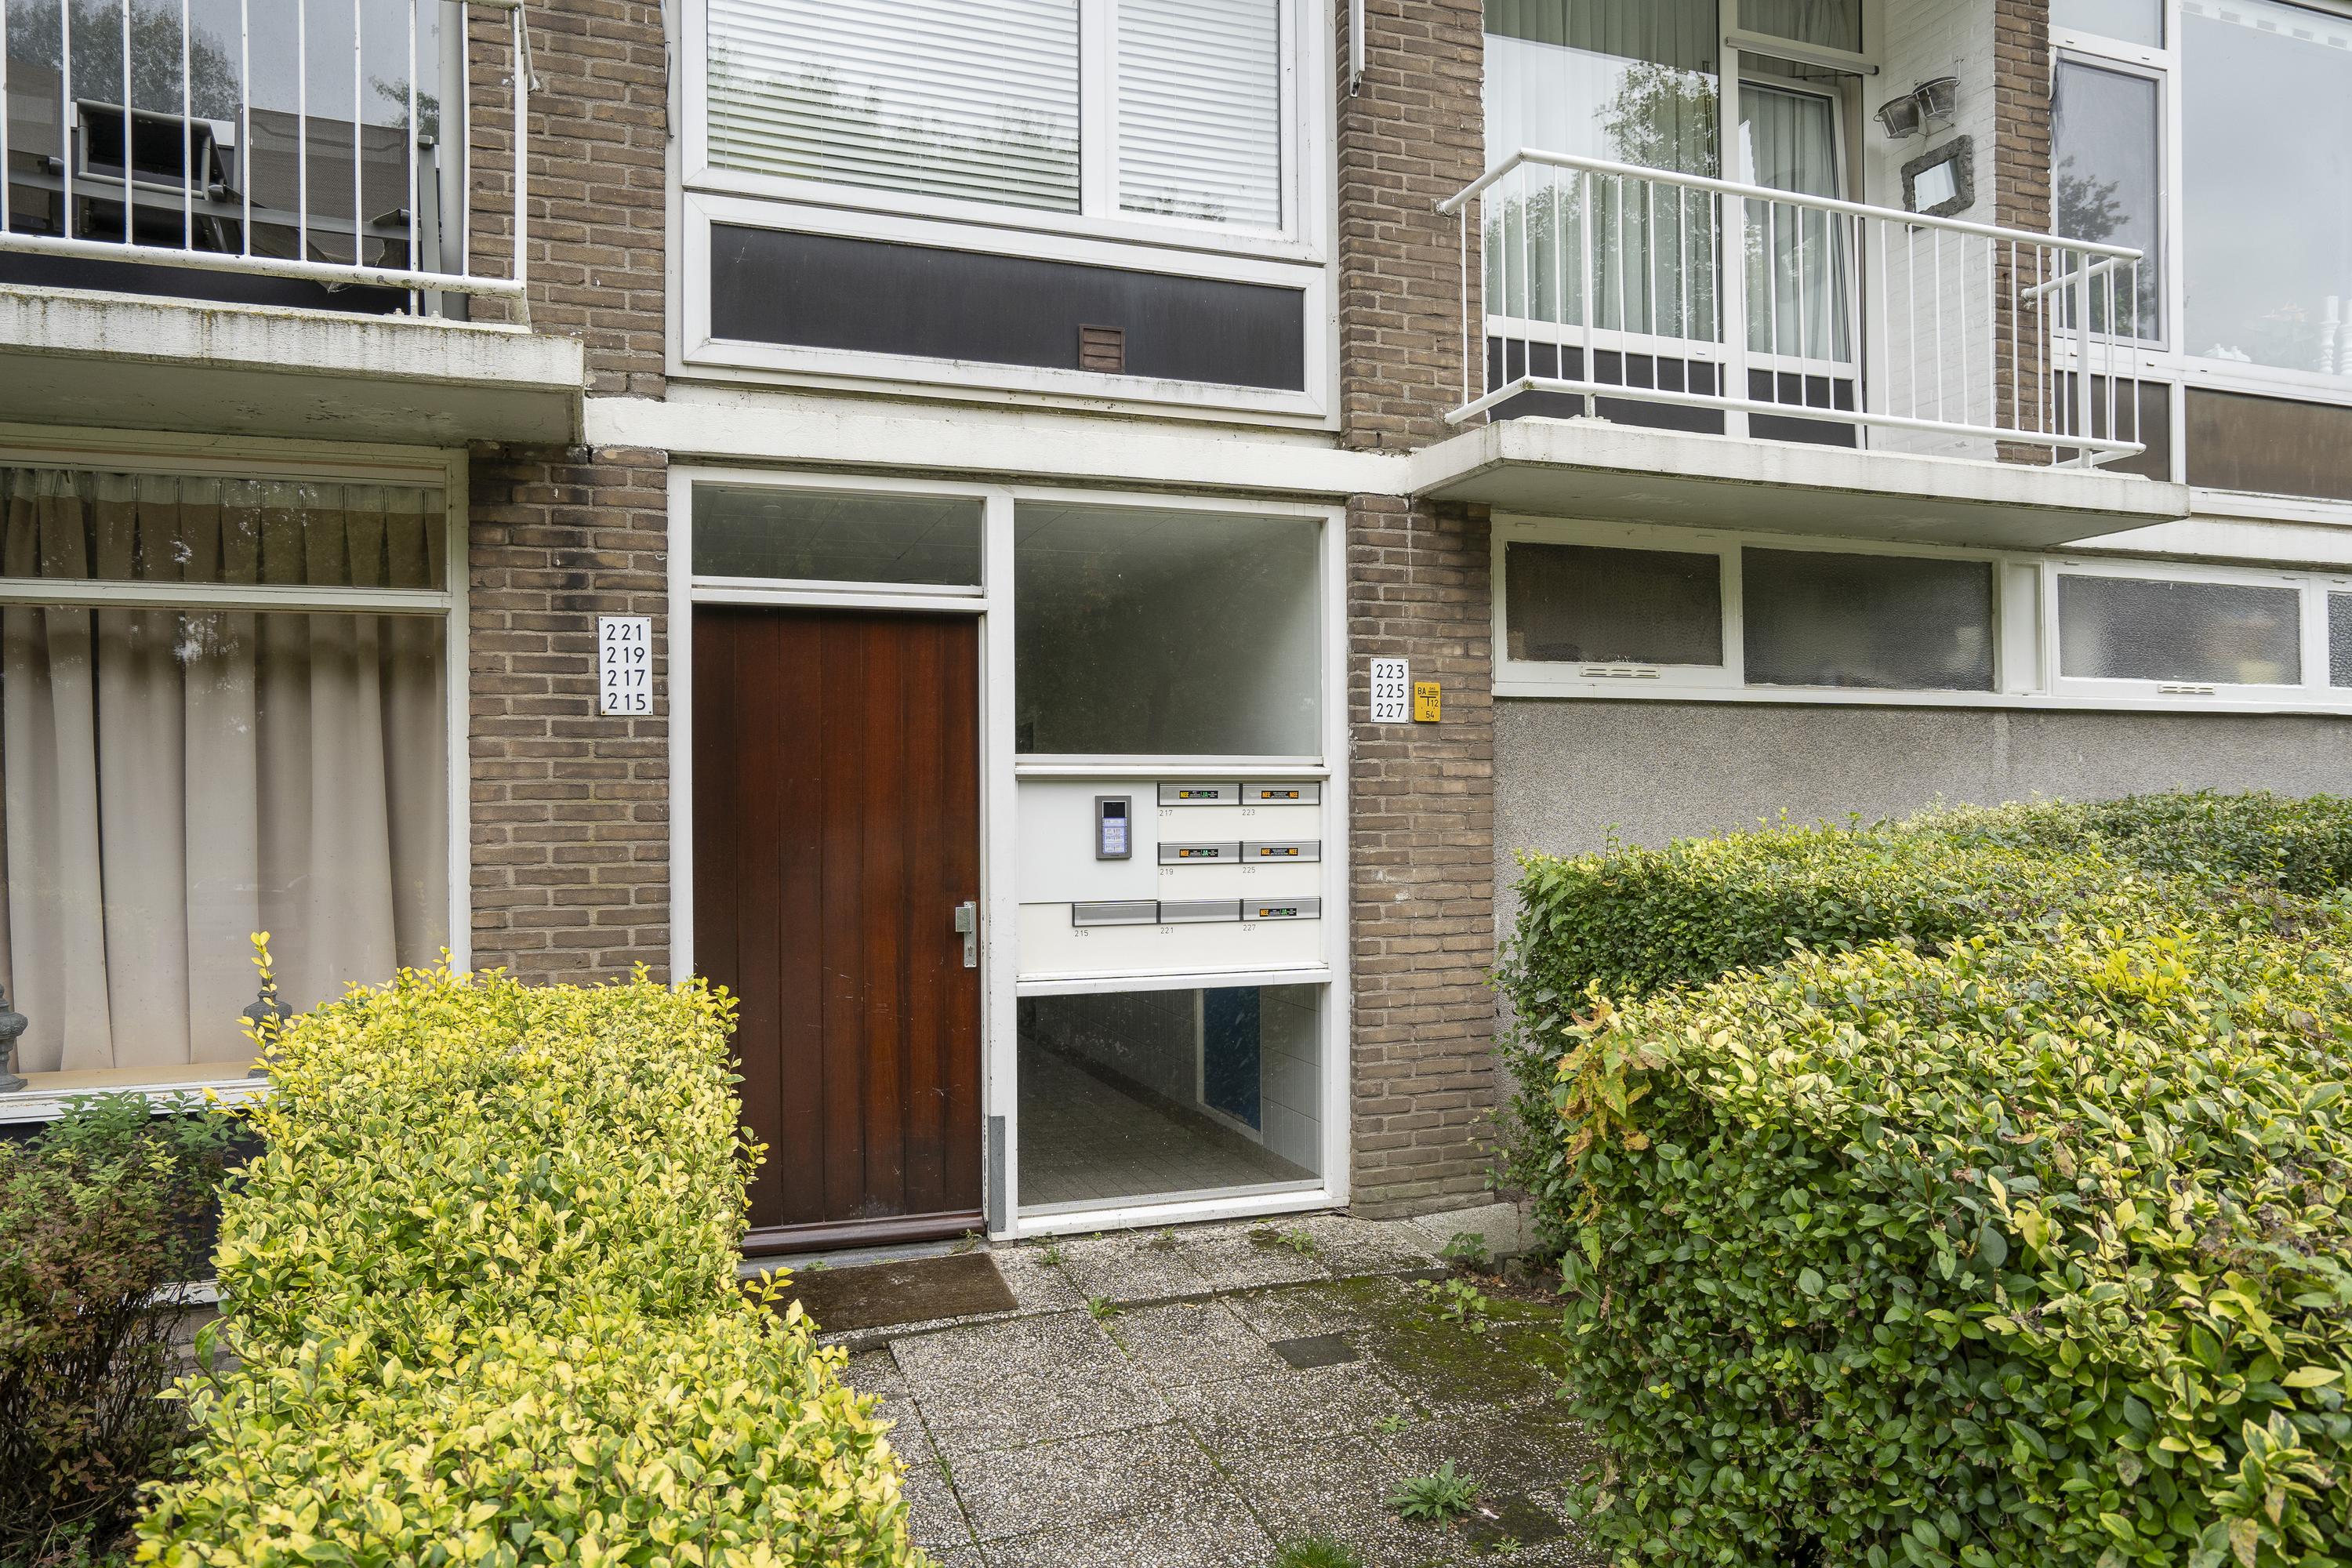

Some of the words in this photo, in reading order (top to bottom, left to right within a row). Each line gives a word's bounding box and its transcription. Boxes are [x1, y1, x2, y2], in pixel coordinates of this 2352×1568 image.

[606, 623, 641, 641] 221
[606, 646, 645, 663] 219
[607, 669, 645, 686] 217
[1376, 663, 1404, 679] 223
[1376, 683, 1404, 699] 225
[608, 692, 646, 710] 215
[1376, 702, 1404, 717] 227
[1425, 710, 1435, 719] 54
